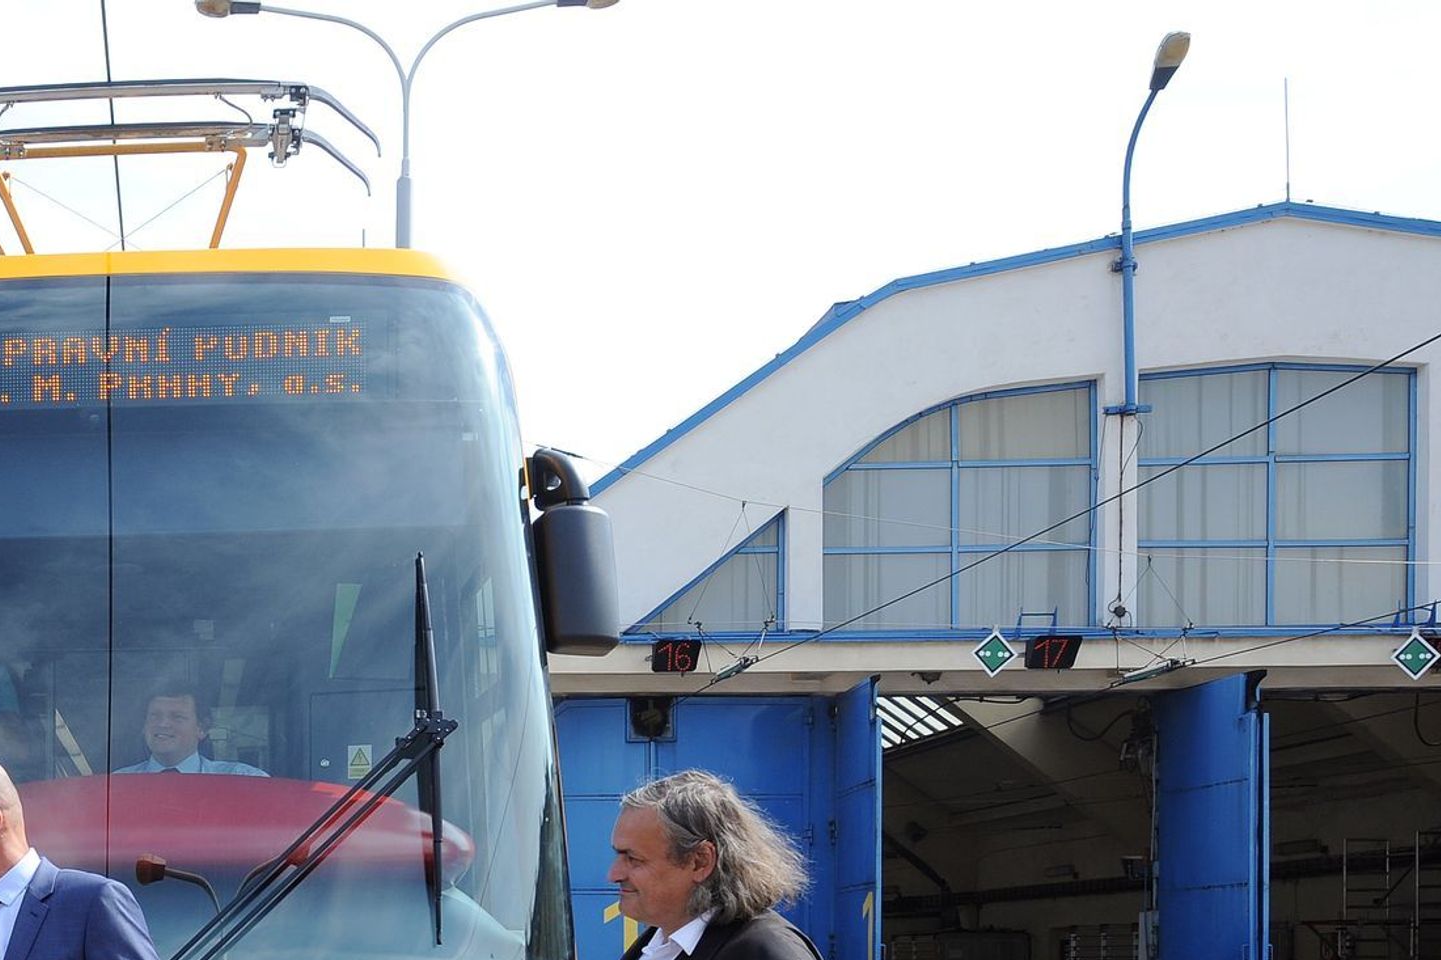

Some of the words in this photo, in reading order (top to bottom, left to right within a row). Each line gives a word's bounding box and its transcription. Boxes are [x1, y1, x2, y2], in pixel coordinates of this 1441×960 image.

[32, 373, 77, 402] M.
[657, 642, 691, 672] 16
[1034, 638, 1069, 669] 17
